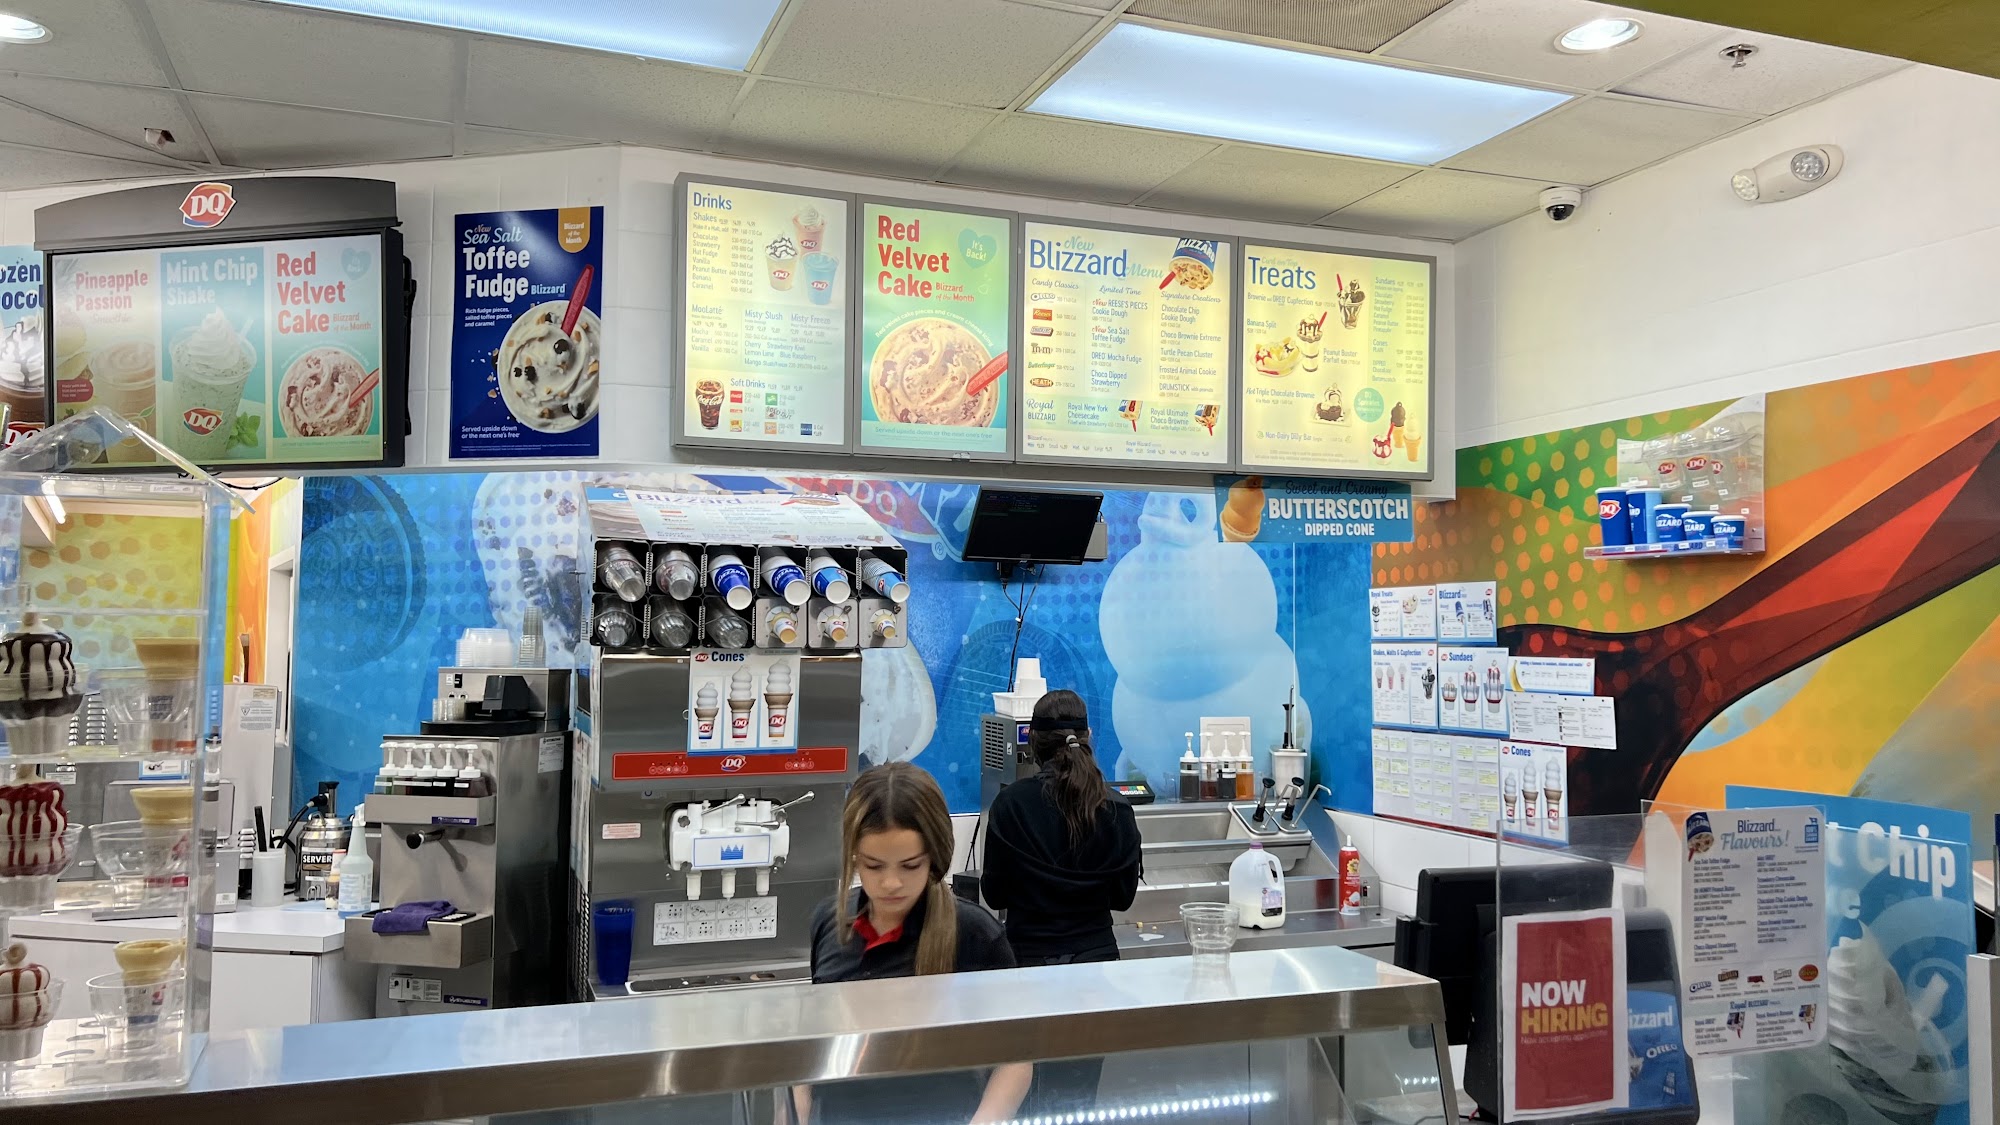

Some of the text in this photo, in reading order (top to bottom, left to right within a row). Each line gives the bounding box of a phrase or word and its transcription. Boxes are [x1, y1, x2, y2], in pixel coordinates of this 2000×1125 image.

[190, 193, 226, 219] DQ
[694, 192, 732, 210] Drinks
[694, 212, 717, 222] Shakes
[474, 225, 492, 233] New
[564, 222, 584, 230] Blizzard
[878, 215, 920, 242] Red
[463, 227, 523, 245] Sea Salt
[693, 232, 718, 241] Chocolate
[693, 240, 720, 250] Strawberry
[1064, 236, 1094, 251] New
[463, 247, 530, 270] Toffee
[878, 244, 949, 273] Velvet
[966, 249, 987, 261] Back!
[1030, 239, 1164, 279] Blizzard Menu
[277, 252, 316, 277] Red
[693, 257, 710, 265] Vanilla
[167, 260, 257, 285] Mint Chip
[693, 265, 710, 273] Peanut
[1248, 257, 1316, 289] Treats
[76, 270, 148, 292] Pineapple
[692, 273, 711, 281] Banana
[466, 274, 565, 302] Fudge Blizzard
[692, 281, 713, 290] Caramel
[878, 271, 963, 298] Cake Blizzard
[1032, 278, 1079, 290] Candy Classics
[278, 281, 345, 305] Velvet
[1099, 286, 1141, 295] Limited Time
[167, 288, 214, 305] Shake
[1161, 291, 1221, 303] Signature Creations
[76, 294, 132, 311] Passion
[1108, 299, 1128, 308] REESE'S
[1130, 302, 1147, 310] PIECES
[1092, 307, 1128, 318] Cookie Dough
[1162, 304, 1200, 315] Chocolate Chip
[745, 310, 782, 320] Misty Slush
[791, 314, 830, 324] Misty Freeze
[1161, 313, 1196, 324] Cookie Dough
[278, 309, 359, 334] Cake Blizzard
[1247, 319, 1264, 327] Banana
[1107, 326, 1117, 334] Sea
[692, 336, 712, 344] Caramel
[1092, 333, 1125, 344] Toffee Fudge
[1178, 332, 1198, 340] Brownie
[692, 344, 709, 352] Vanilla
[767, 343, 793, 351] Strawberry
[792, 353, 816, 361] Raspberry
[1161, 348, 1213, 358] Turtle Pecan Cluster
[1324, 348, 1340, 357] Peanut
[1107, 353, 1125, 361] Mocha
[1126, 355, 1142, 364] Fudge
[1324, 355, 1339, 364] Parfait
[1109, 371, 1127, 380] Dipped
[1160, 366, 1178, 374] Frosted
[1180, 367, 1197, 375] Animal
[746, 380, 765, 388] Drinks
[1031, 378, 1051, 386] HEATH
[1091, 378, 1120, 388] Strawberry
[1160, 383, 1189, 391] DRUMSTICK
[1256, 388, 1270, 396] Triple
[1271, 389, 1295, 398] Chocolate
[1296, 390, 1315, 398] Brownie
[1027, 398, 1054, 413] Royal
[1068, 403, 1083, 412] Royal
[1028, 412, 1056, 421] BLIZZARD
[1068, 411, 1099, 420] Cheesecake
[1151, 408, 1188, 417] Royal Ultimate
[188, 412, 219, 429] DQ
[1151, 416, 1189, 425] Choco Brownie
[1689, 459, 1705, 467] DQ
[1286, 481, 1388, 498] Sweet and Creamy
[853, 481, 898, 518] DQ
[1268, 499, 1408, 519] BUTTERSCOTCH
[1599, 504, 1615, 515] DQ
[1305, 524, 1374, 536] DIPPED CONE
[711, 651, 745, 662] Cones
[1449, 653, 1473, 661] Sundaes
[734, 719, 748, 727] DQ
[770, 716, 784, 725] DQ
[1511, 746, 1531, 756] Cones
[724, 758, 743, 768] DQ
[1738, 818, 1775, 833] Blizzard
[1720, 830, 1791, 851] Flavours!
[303, 854, 332, 864] SERVER
[1857, 821, 1956, 899] Chip
[1521, 979, 1586, 1007] NOW
[1521, 1003, 1608, 1034] HIRING
[1646, 1044, 1677, 1058] OREO
